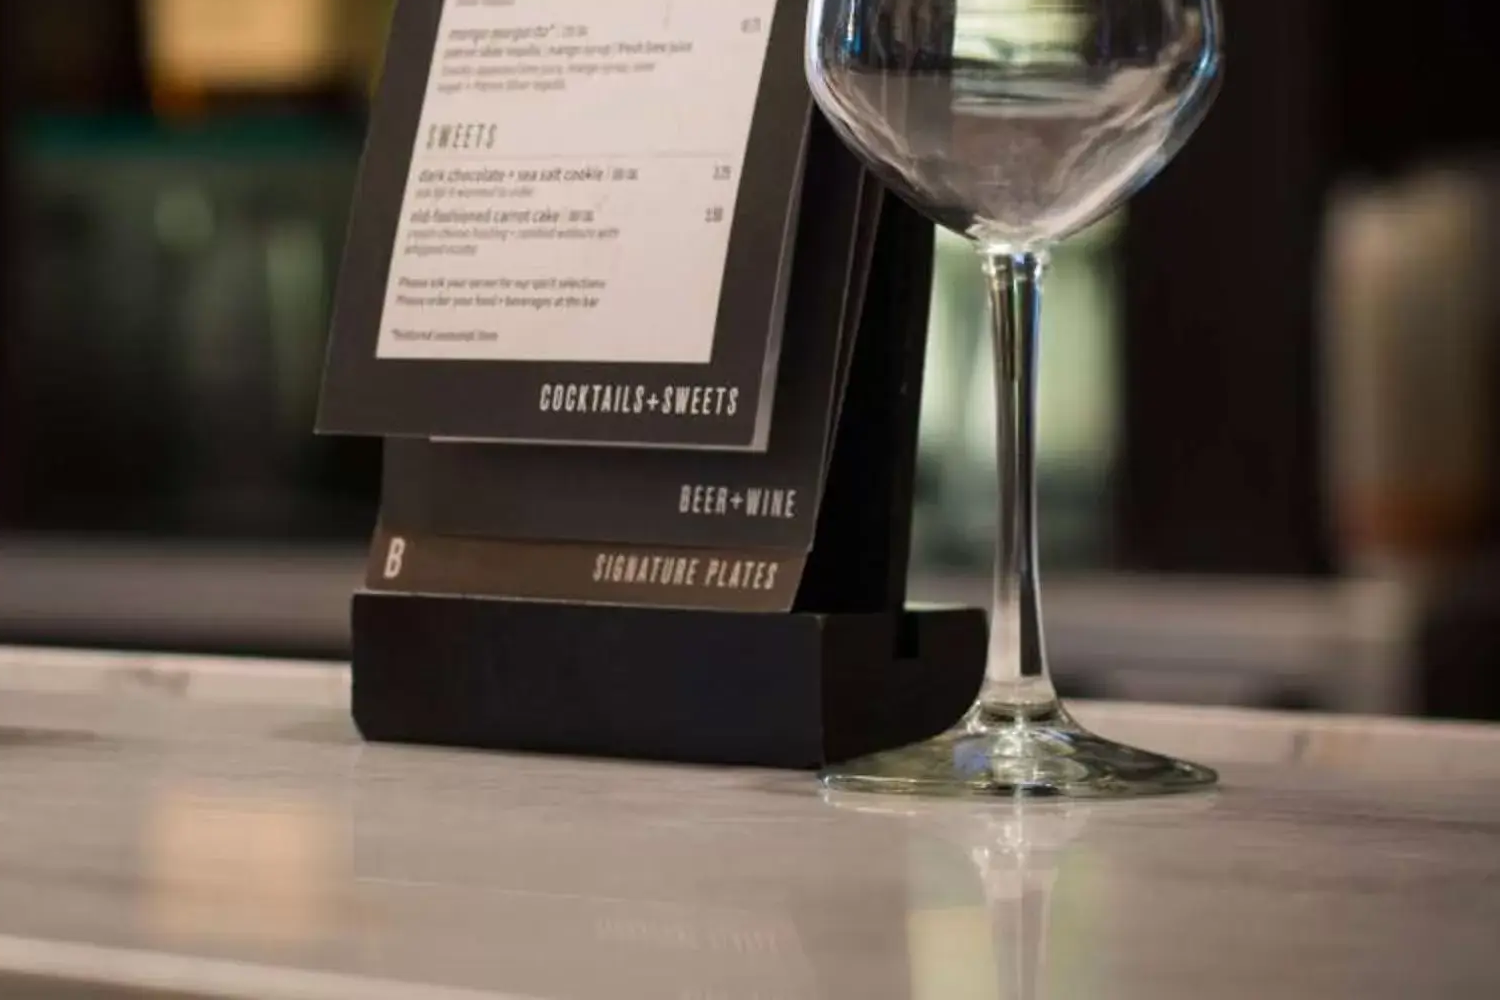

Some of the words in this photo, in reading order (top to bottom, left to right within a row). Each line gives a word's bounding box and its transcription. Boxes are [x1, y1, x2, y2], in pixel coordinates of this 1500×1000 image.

[426, 123, 498, 150] SWEETS
[539, 383, 740, 417] COCKTAILS+SWEETS
[678, 484, 797, 519] BEER+WINE
[383, 537, 407, 579] B
[592, 553, 698, 586] SIGNATURE
[704, 560, 780, 590] PLATES
